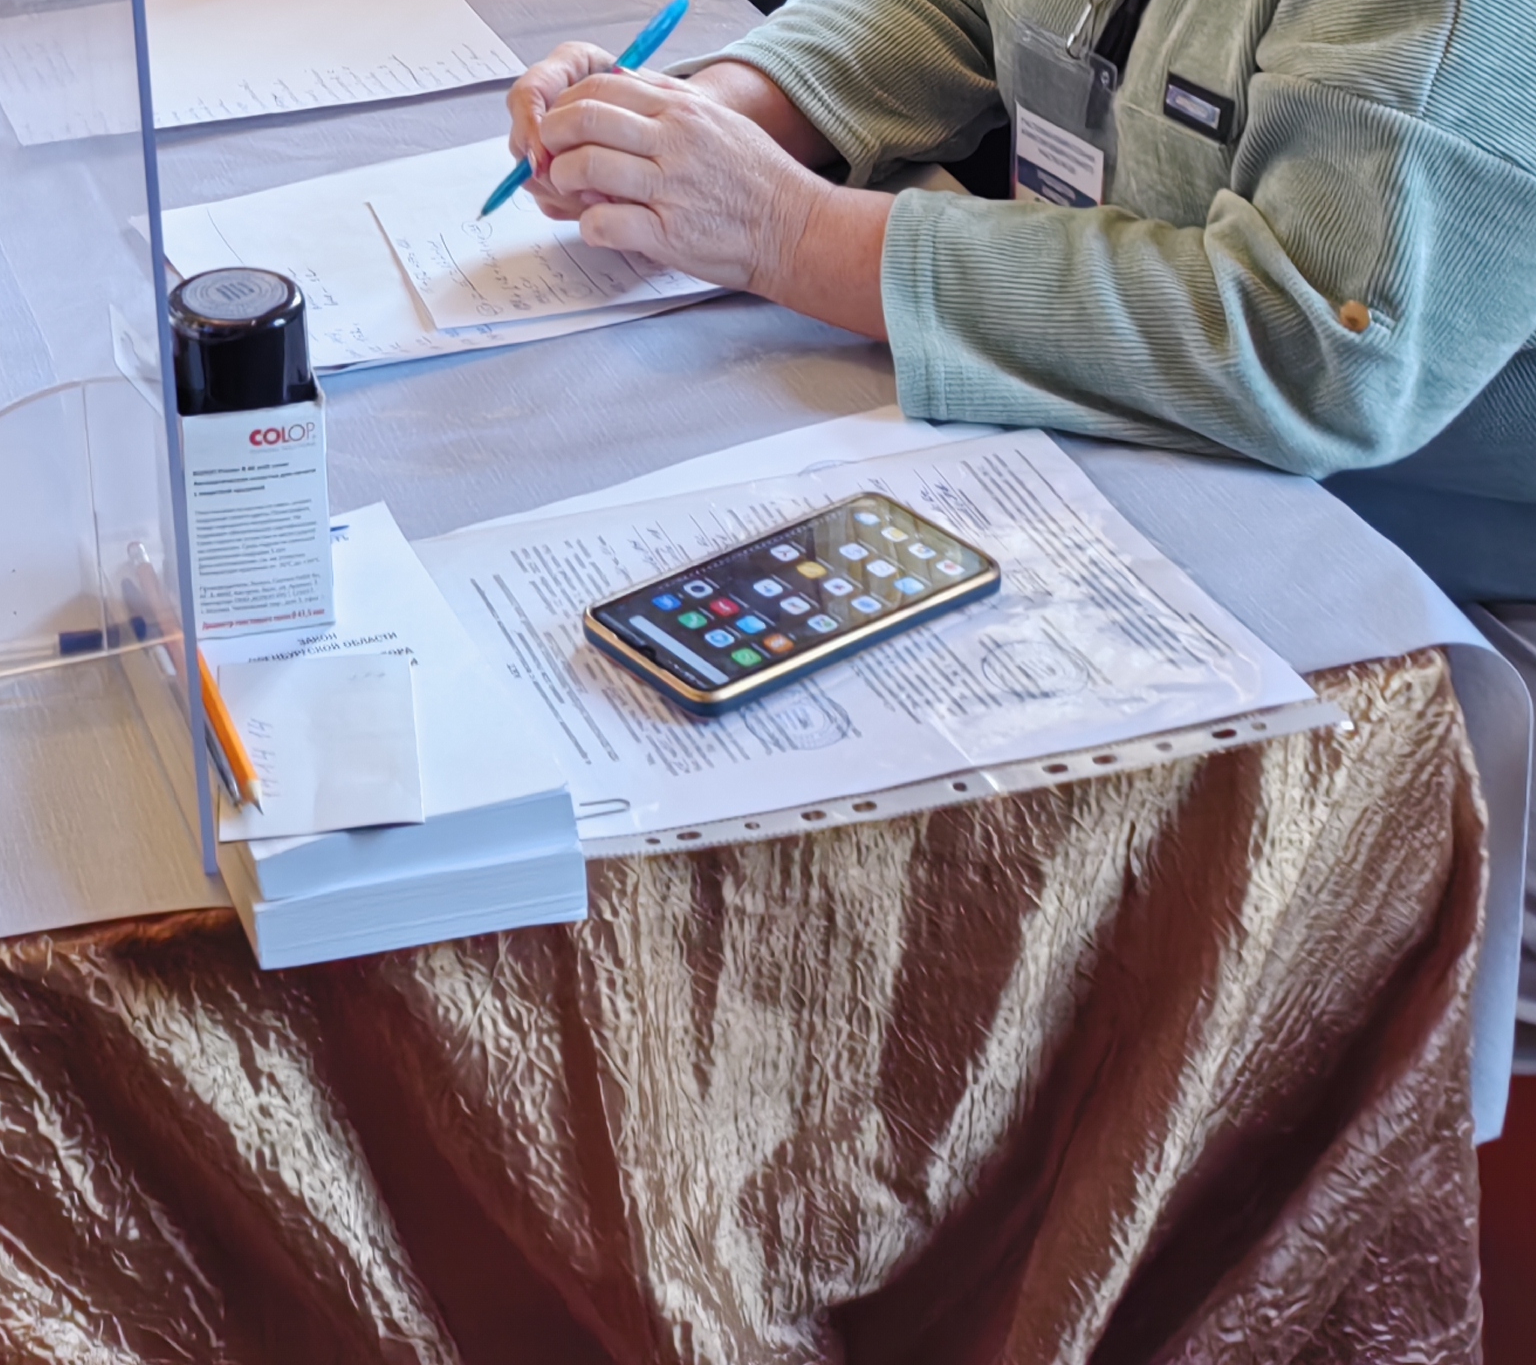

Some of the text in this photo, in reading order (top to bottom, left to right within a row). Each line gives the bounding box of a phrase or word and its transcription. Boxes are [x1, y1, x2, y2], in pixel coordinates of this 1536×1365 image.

[249, 421, 316, 447] COLOP
[298, 632, 338, 646] ЗАКОН
[343, 632, 398, 649] ОБЛАСТИ
